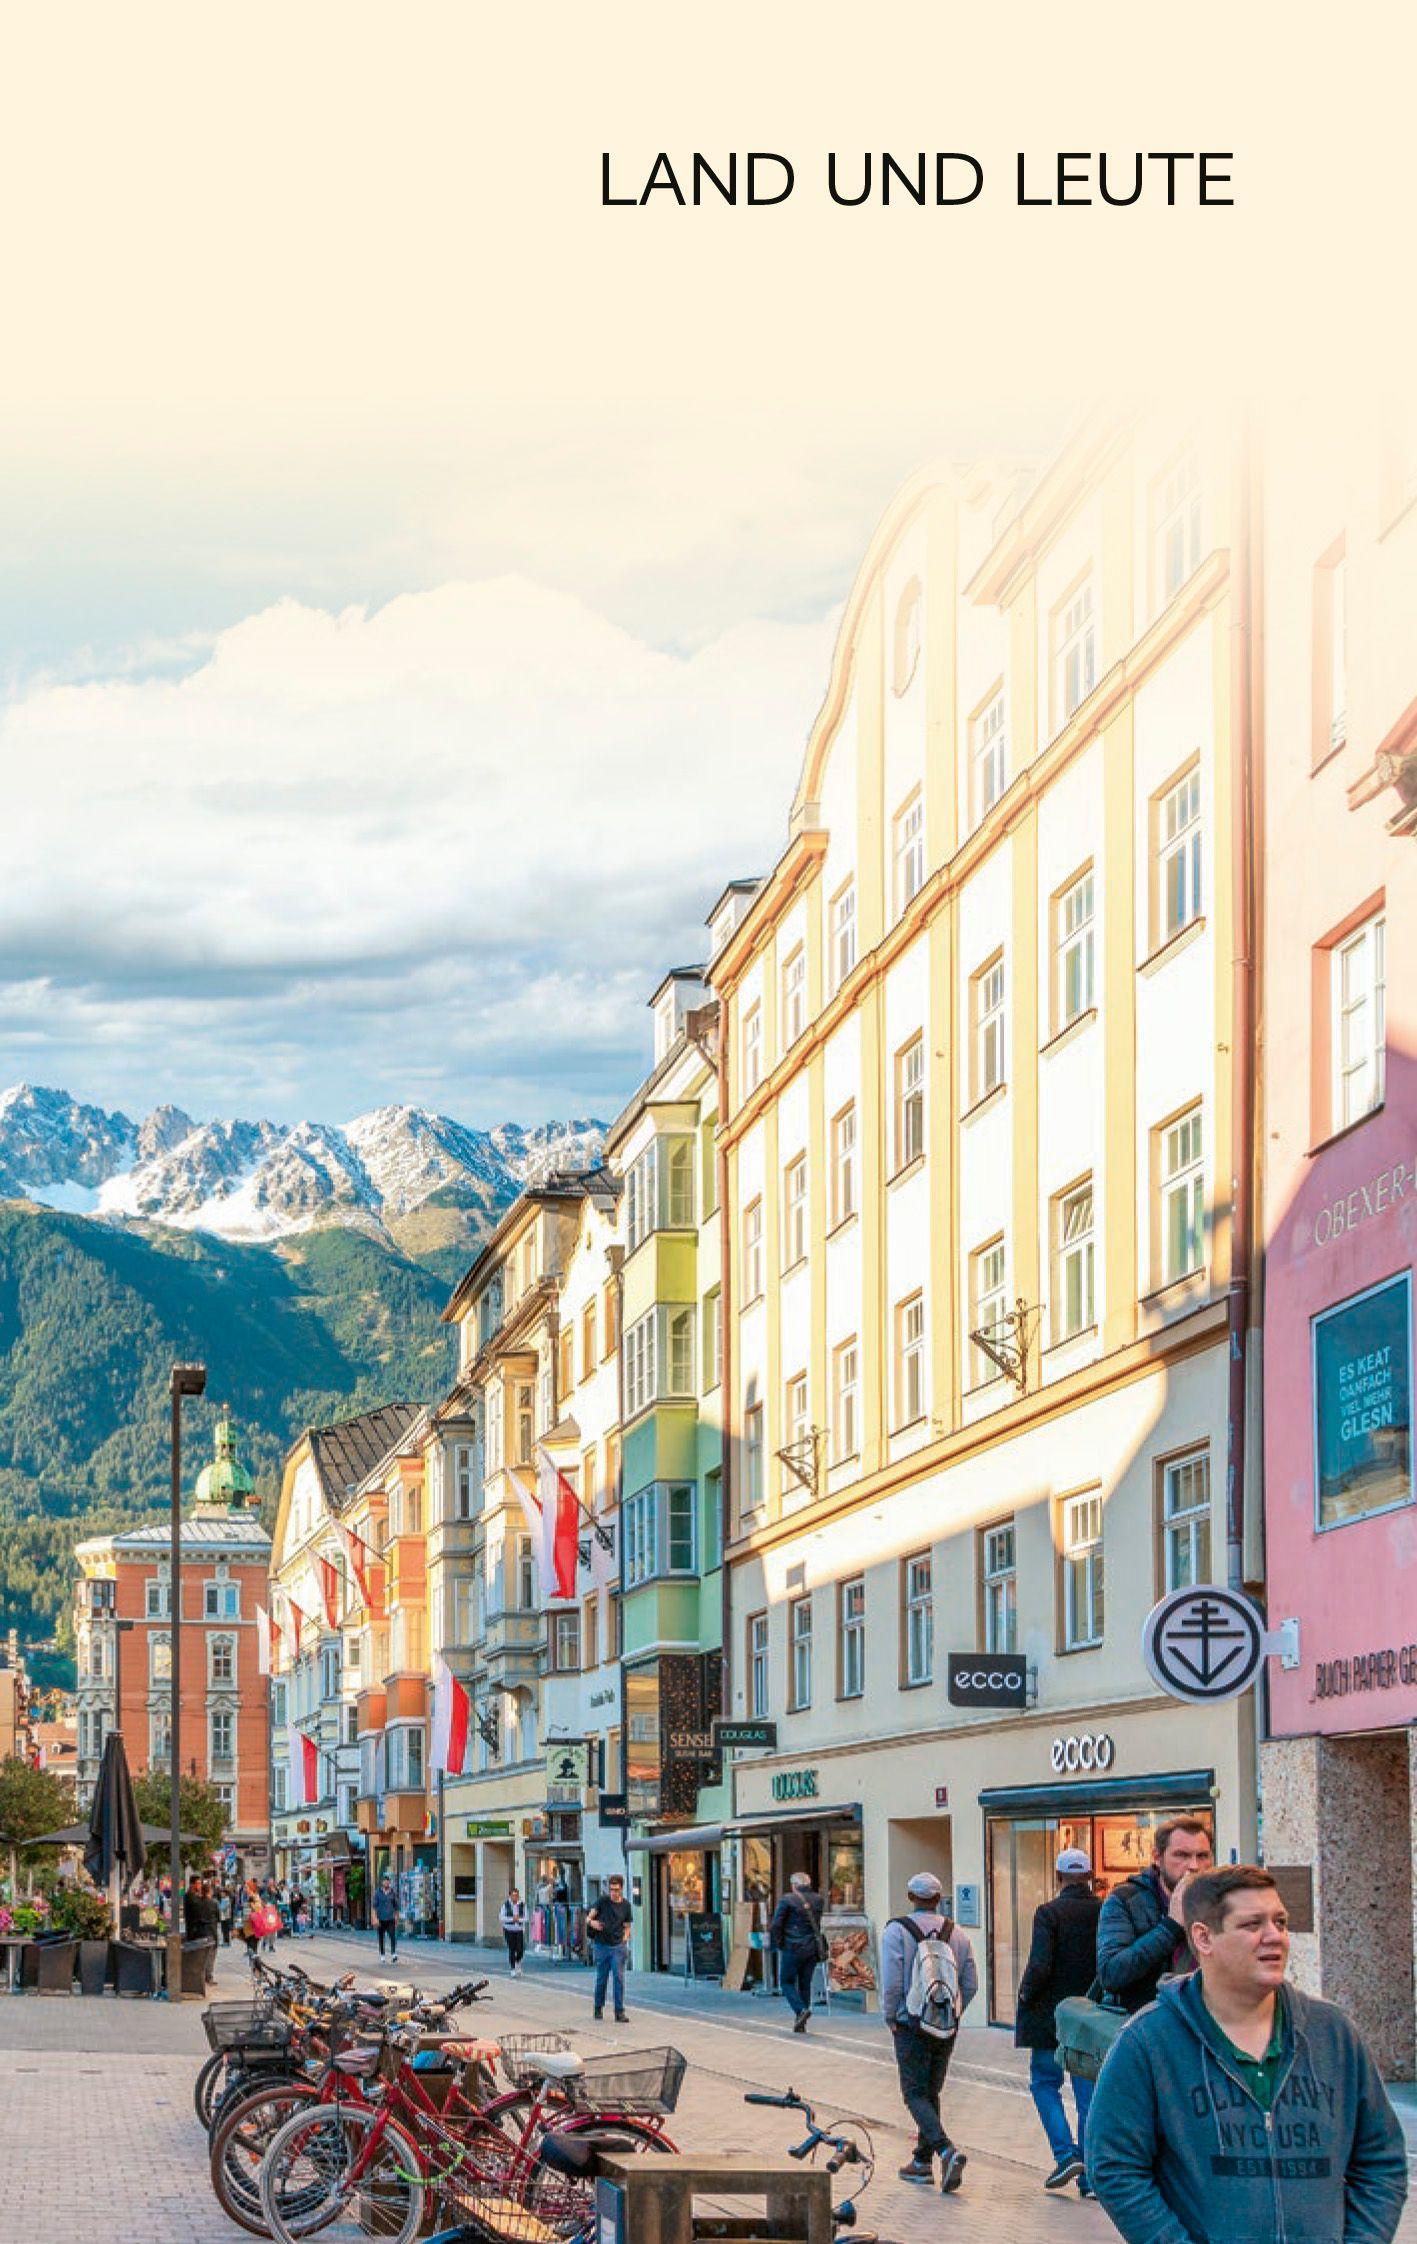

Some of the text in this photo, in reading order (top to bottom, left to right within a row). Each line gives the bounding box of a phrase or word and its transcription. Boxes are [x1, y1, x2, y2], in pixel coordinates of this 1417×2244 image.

[1339, 1345, 1391, 1384] ES KEAT
[1341, 1402, 1393, 1441] GLESN
[955, 1671, 1022, 1689] ecco
[720, 1730, 768, 1740] DOUGLAS
[1051, 1734, 1114, 1774] ecco
[1219, 2121, 1321, 2149] NYC USA
